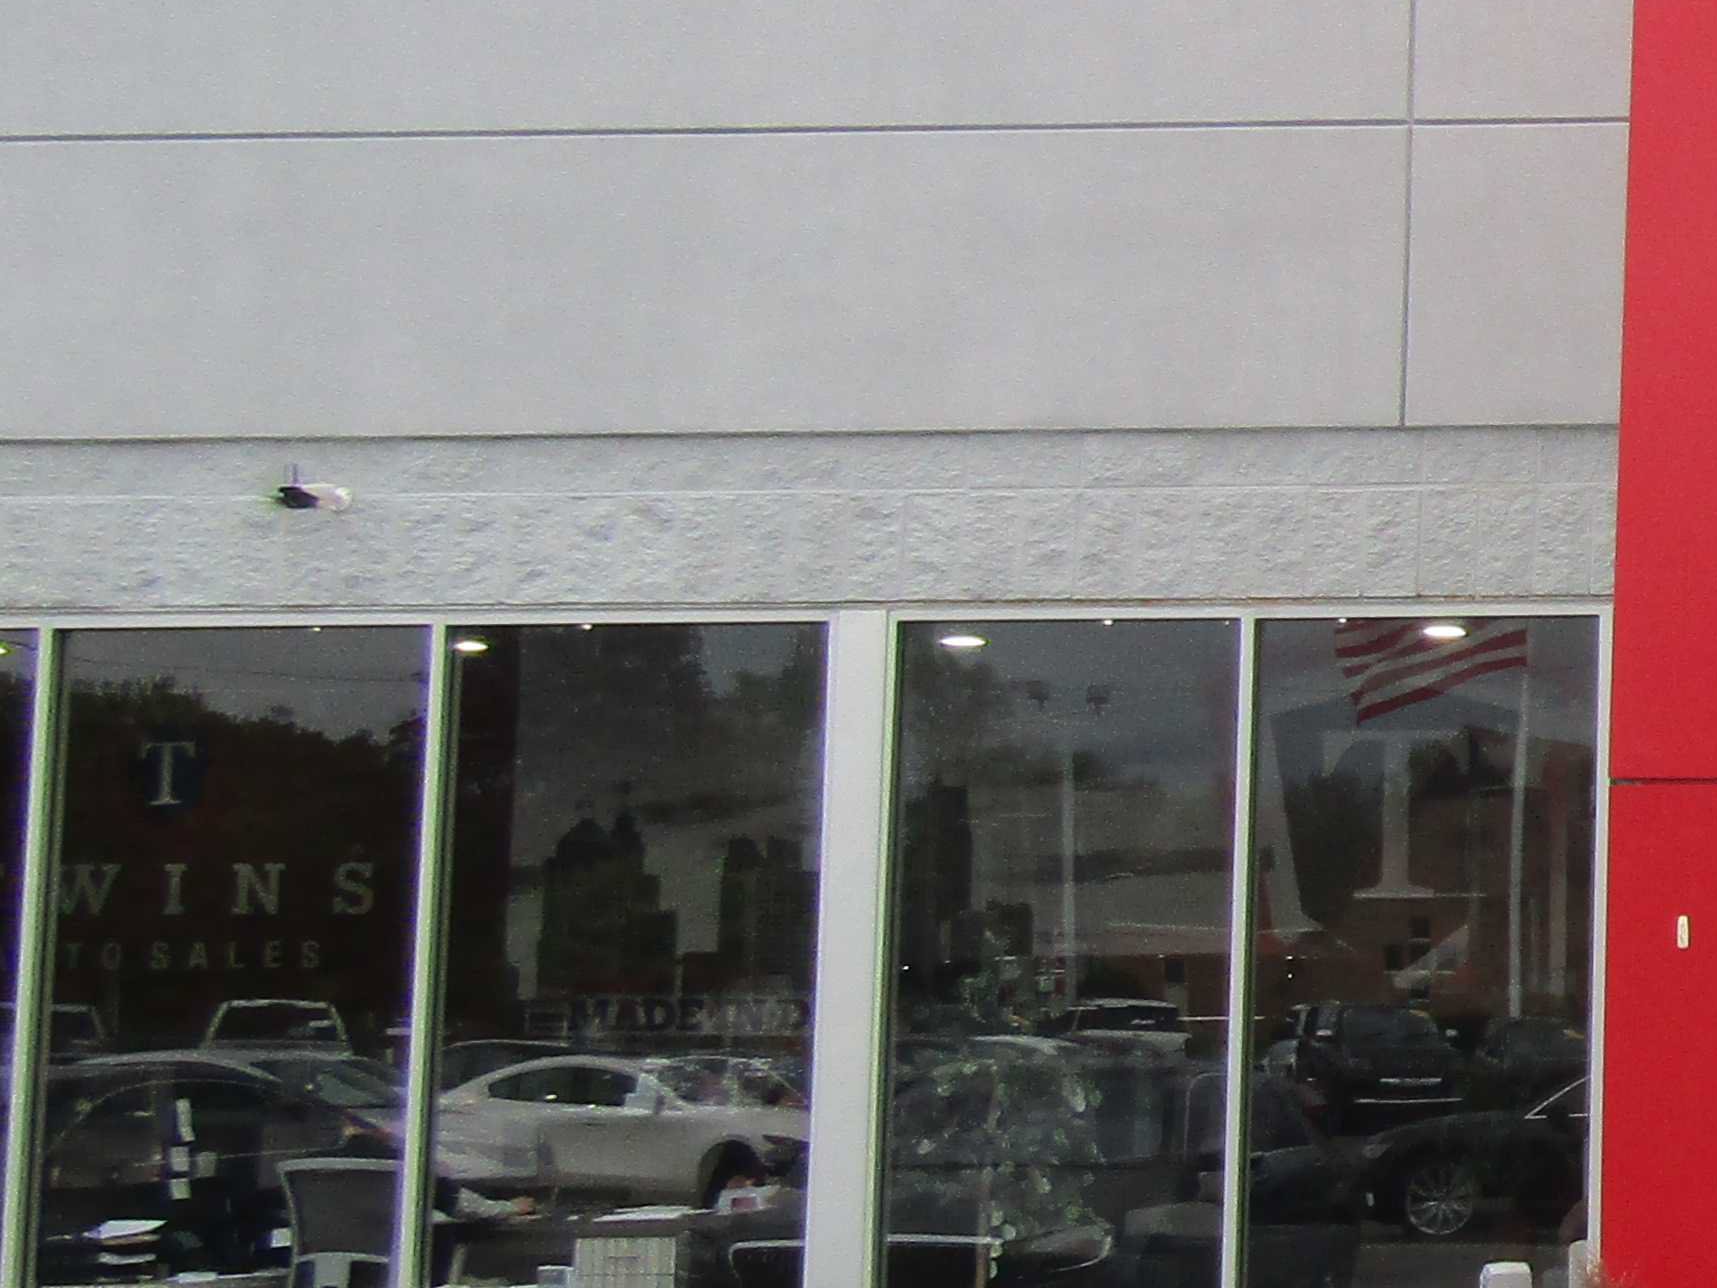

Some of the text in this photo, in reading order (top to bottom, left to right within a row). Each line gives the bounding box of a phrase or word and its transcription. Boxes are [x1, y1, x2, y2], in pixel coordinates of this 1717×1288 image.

[140, 740, 197, 806] T
[0, 860, 376, 915] WINS
[149, 939, 322, 970] SALES
[571, 998, 704, 1032] MADE
